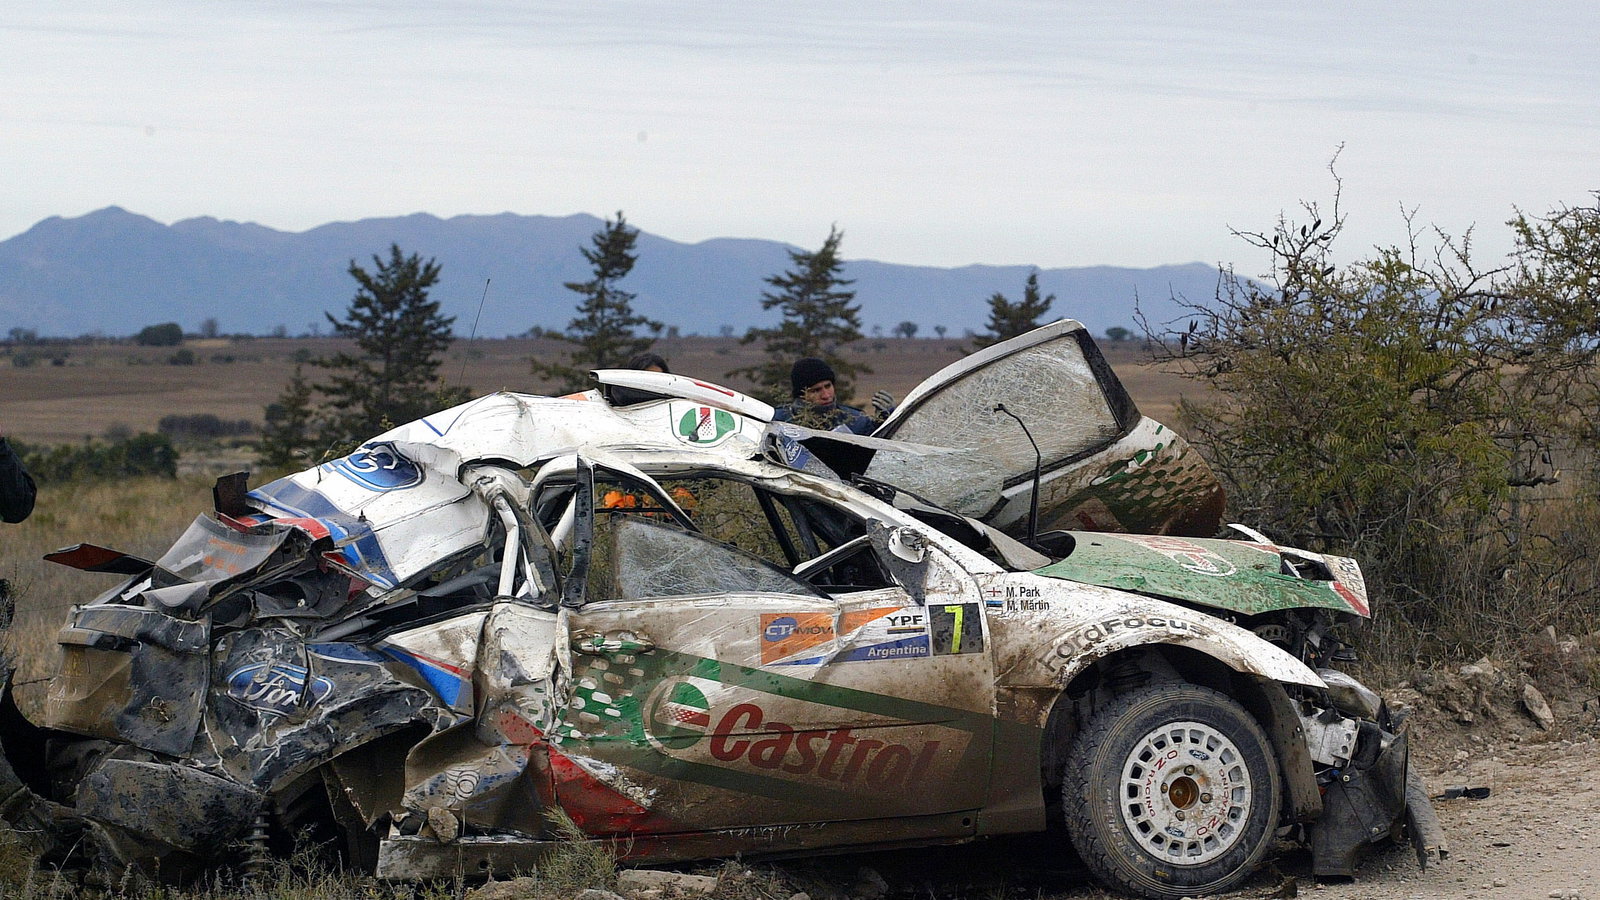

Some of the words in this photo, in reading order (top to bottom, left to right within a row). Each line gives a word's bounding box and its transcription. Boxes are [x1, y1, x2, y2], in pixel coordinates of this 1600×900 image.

[1005, 586, 1018, 598] M.
[1020, 586, 1041, 598] Park
[1006, 600, 1018, 611] M.
[1020, 600, 1050, 611] Märtin
[887, 615, 923, 627] YPF
[944, 605, 964, 654] 7
[867, 644, 927, 658] Argentina
[709, 703, 941, 792] Castrol
[1145, 769, 1156, 817] RACING
